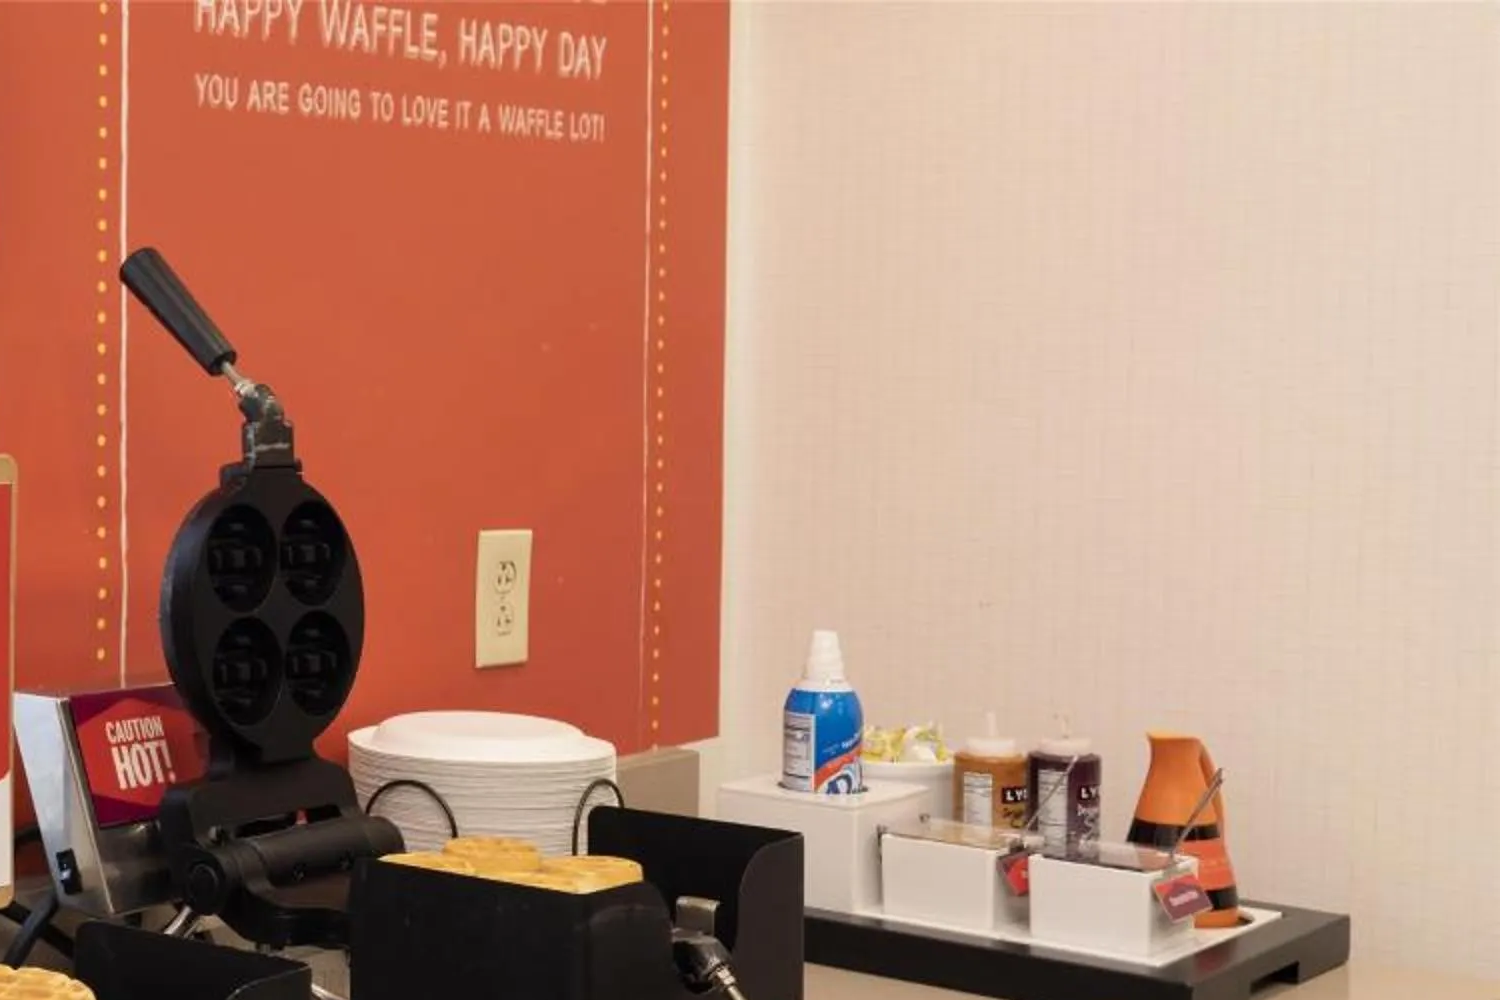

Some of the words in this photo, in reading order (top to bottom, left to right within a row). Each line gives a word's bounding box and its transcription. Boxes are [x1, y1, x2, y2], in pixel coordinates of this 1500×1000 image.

[194, 0, 302, 45] HAPPY
[320, 0, 448, 69] WAFFLE,
[459, 17, 548, 73] HAPPY
[558, 31, 607, 80] DAY
[195, 73, 239, 111] YOU
[247, 80, 290, 115] ARE
[299, 83, 361, 121] GOING
[370, 92, 394, 122] TO
[402, 94, 449, 129] LOVE
[456, 101, 472, 130] IT
[478, 103, 491, 133] A
[498, 104, 564, 140] WAFFLE
[105, 715, 165, 744] CAUTION
[111, 738, 177, 790] HOT!
